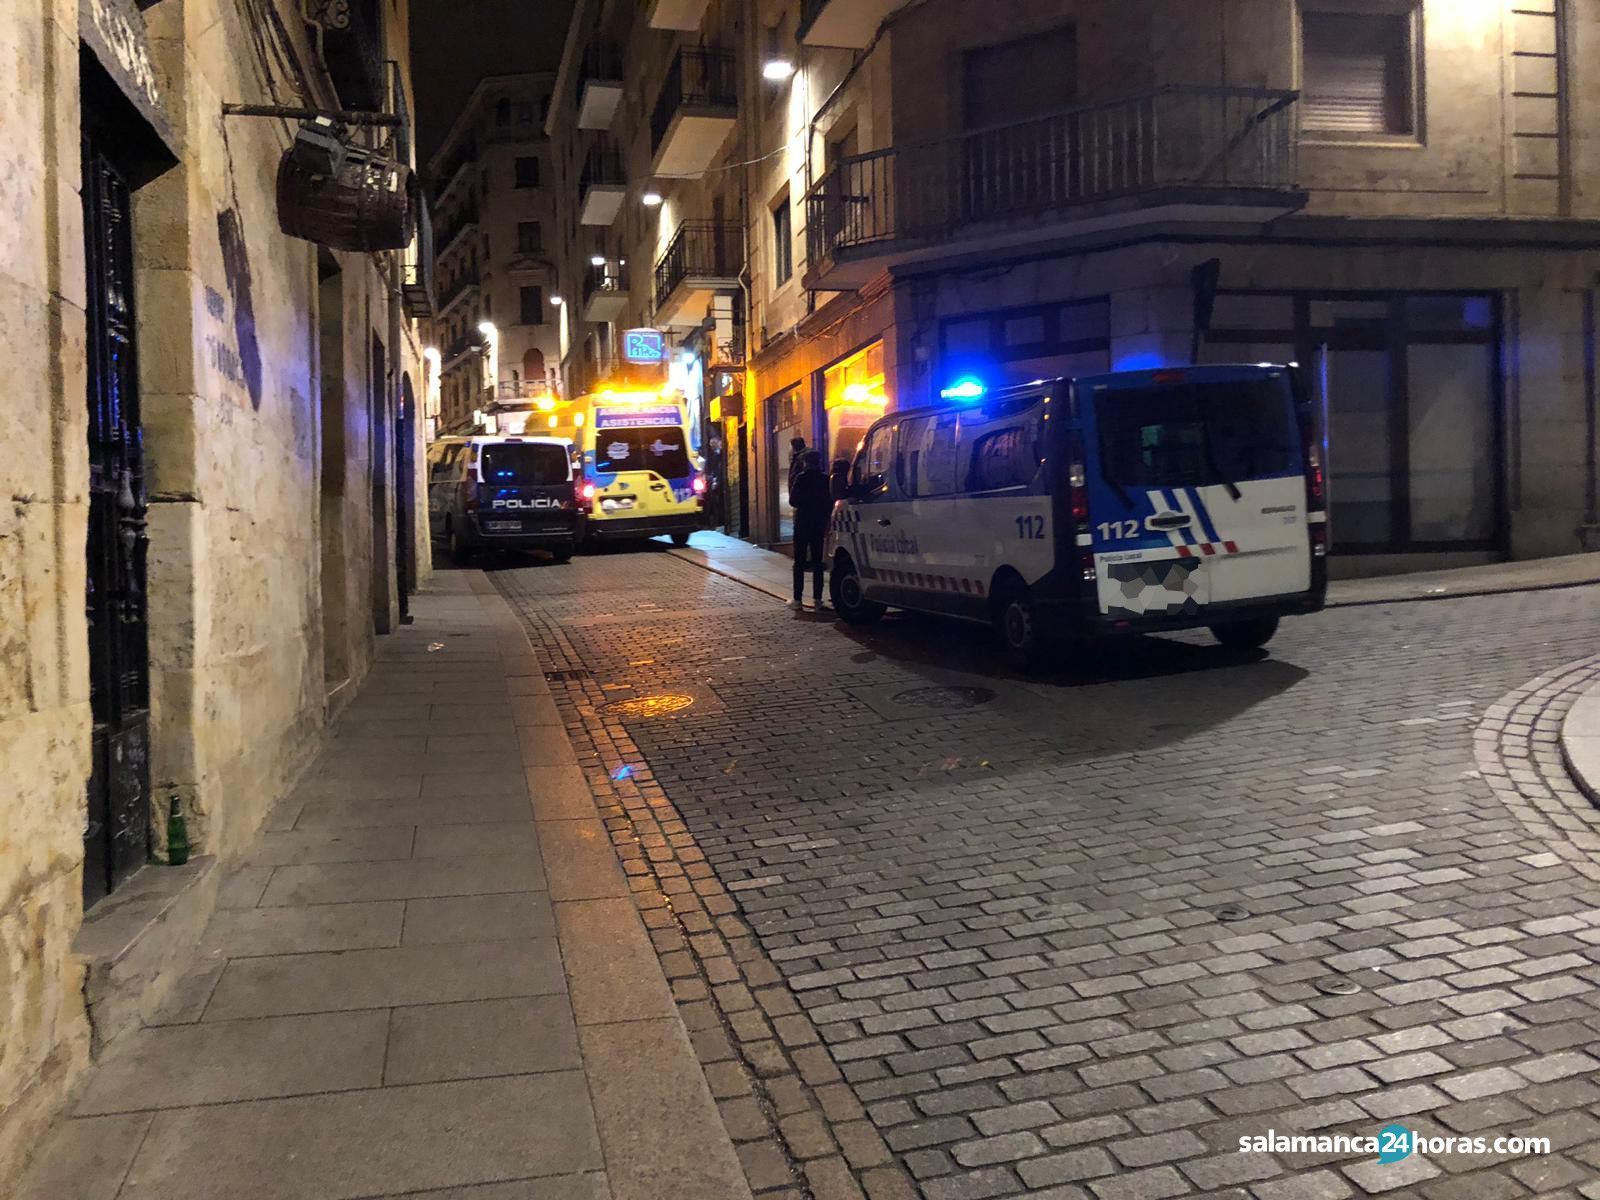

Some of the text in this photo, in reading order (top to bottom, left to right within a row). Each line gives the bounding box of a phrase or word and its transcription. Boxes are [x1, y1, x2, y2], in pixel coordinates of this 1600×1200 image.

[600, 417, 679, 428] ASISTENCIAL
[1015, 515, 1046, 540] 112
[1096, 519, 1140, 541] 112
